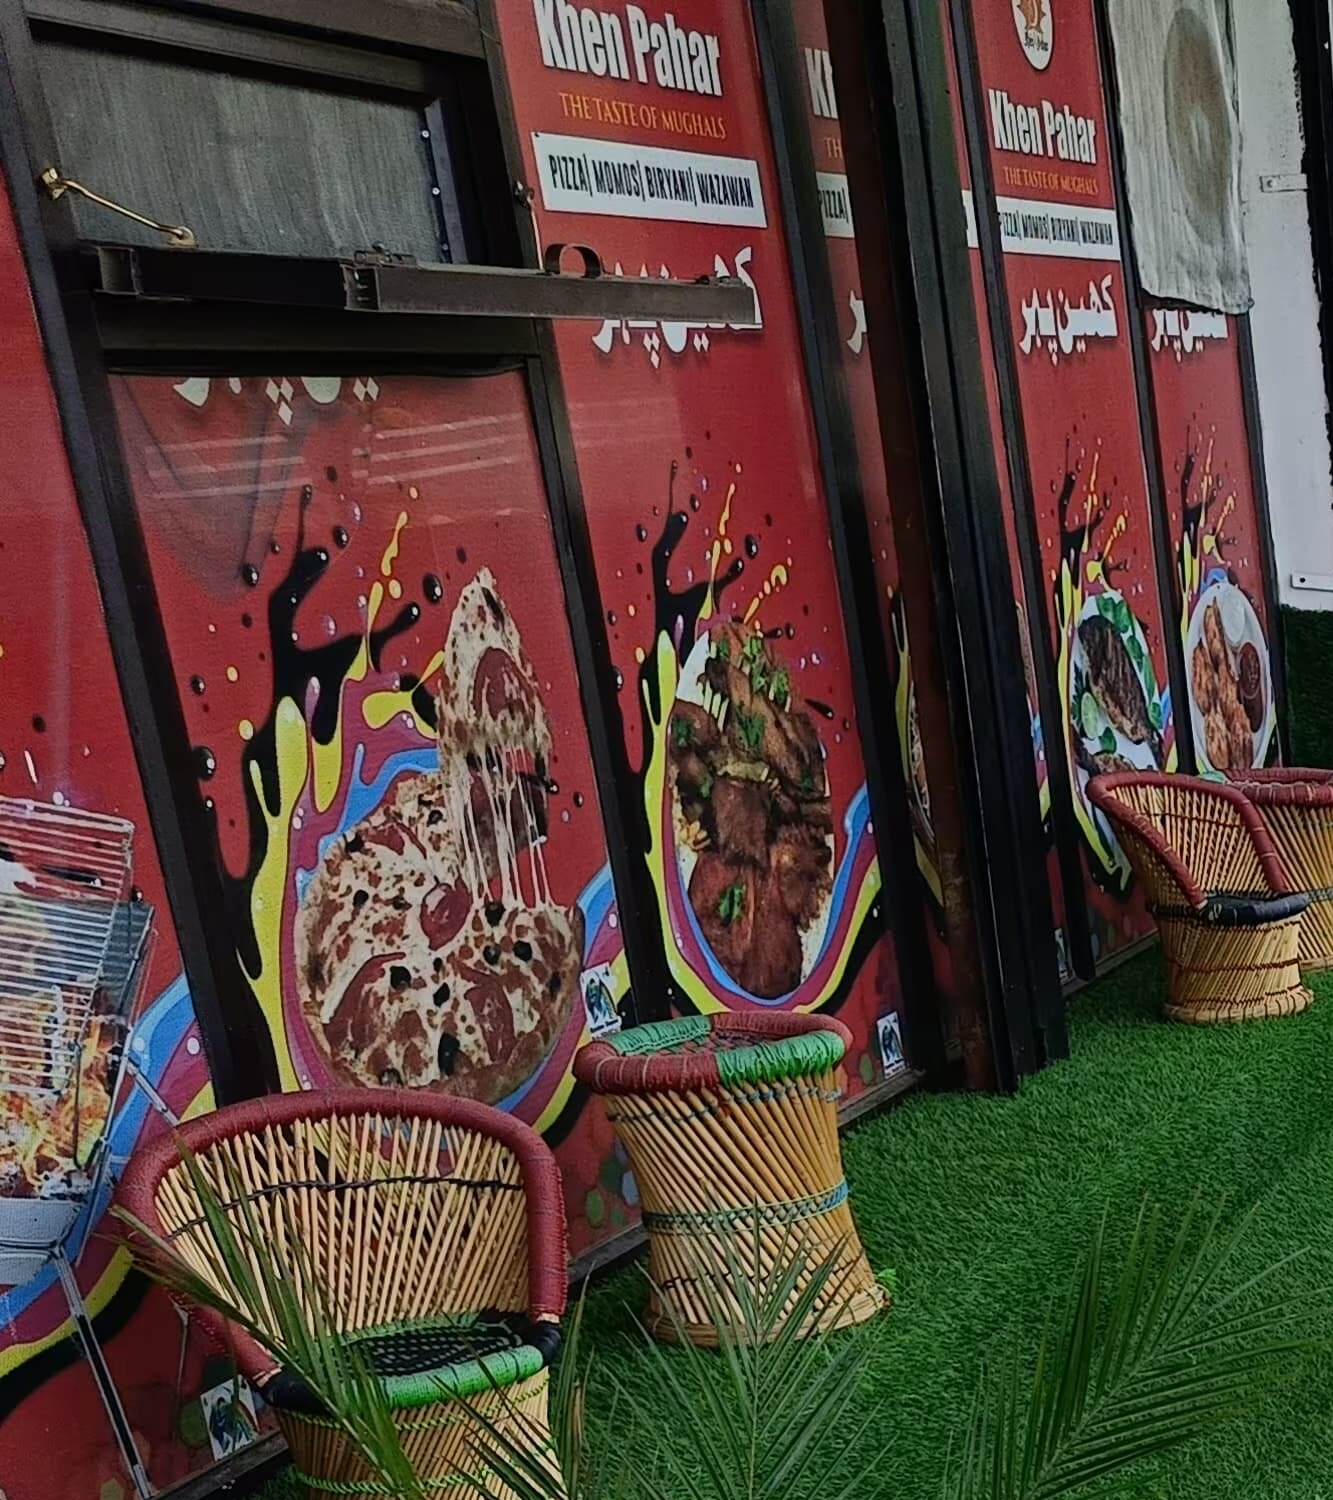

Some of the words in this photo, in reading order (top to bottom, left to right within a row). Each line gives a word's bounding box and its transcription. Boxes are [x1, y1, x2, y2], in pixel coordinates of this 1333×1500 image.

[532, 0, 630, 80] Khen
[625, 3, 723, 96] Pahar
[559, 92, 592, 121] THE
[591, 98, 638, 128] TASTE
[638, 105, 659, 130] OF
[661, 110, 727, 140] MUGHALS
[988, 88, 1044, 156] Khen
[1041, 100, 1097, 165] Pahar
[696, 171, 755, 209] WAZAWAN
[1003, 166, 1022, 185] THE
[1020, 169, 1048, 189] TASTE
[1047, 172, 1059, 190] OF
[1059, 175, 1099, 196] MUGHALS
